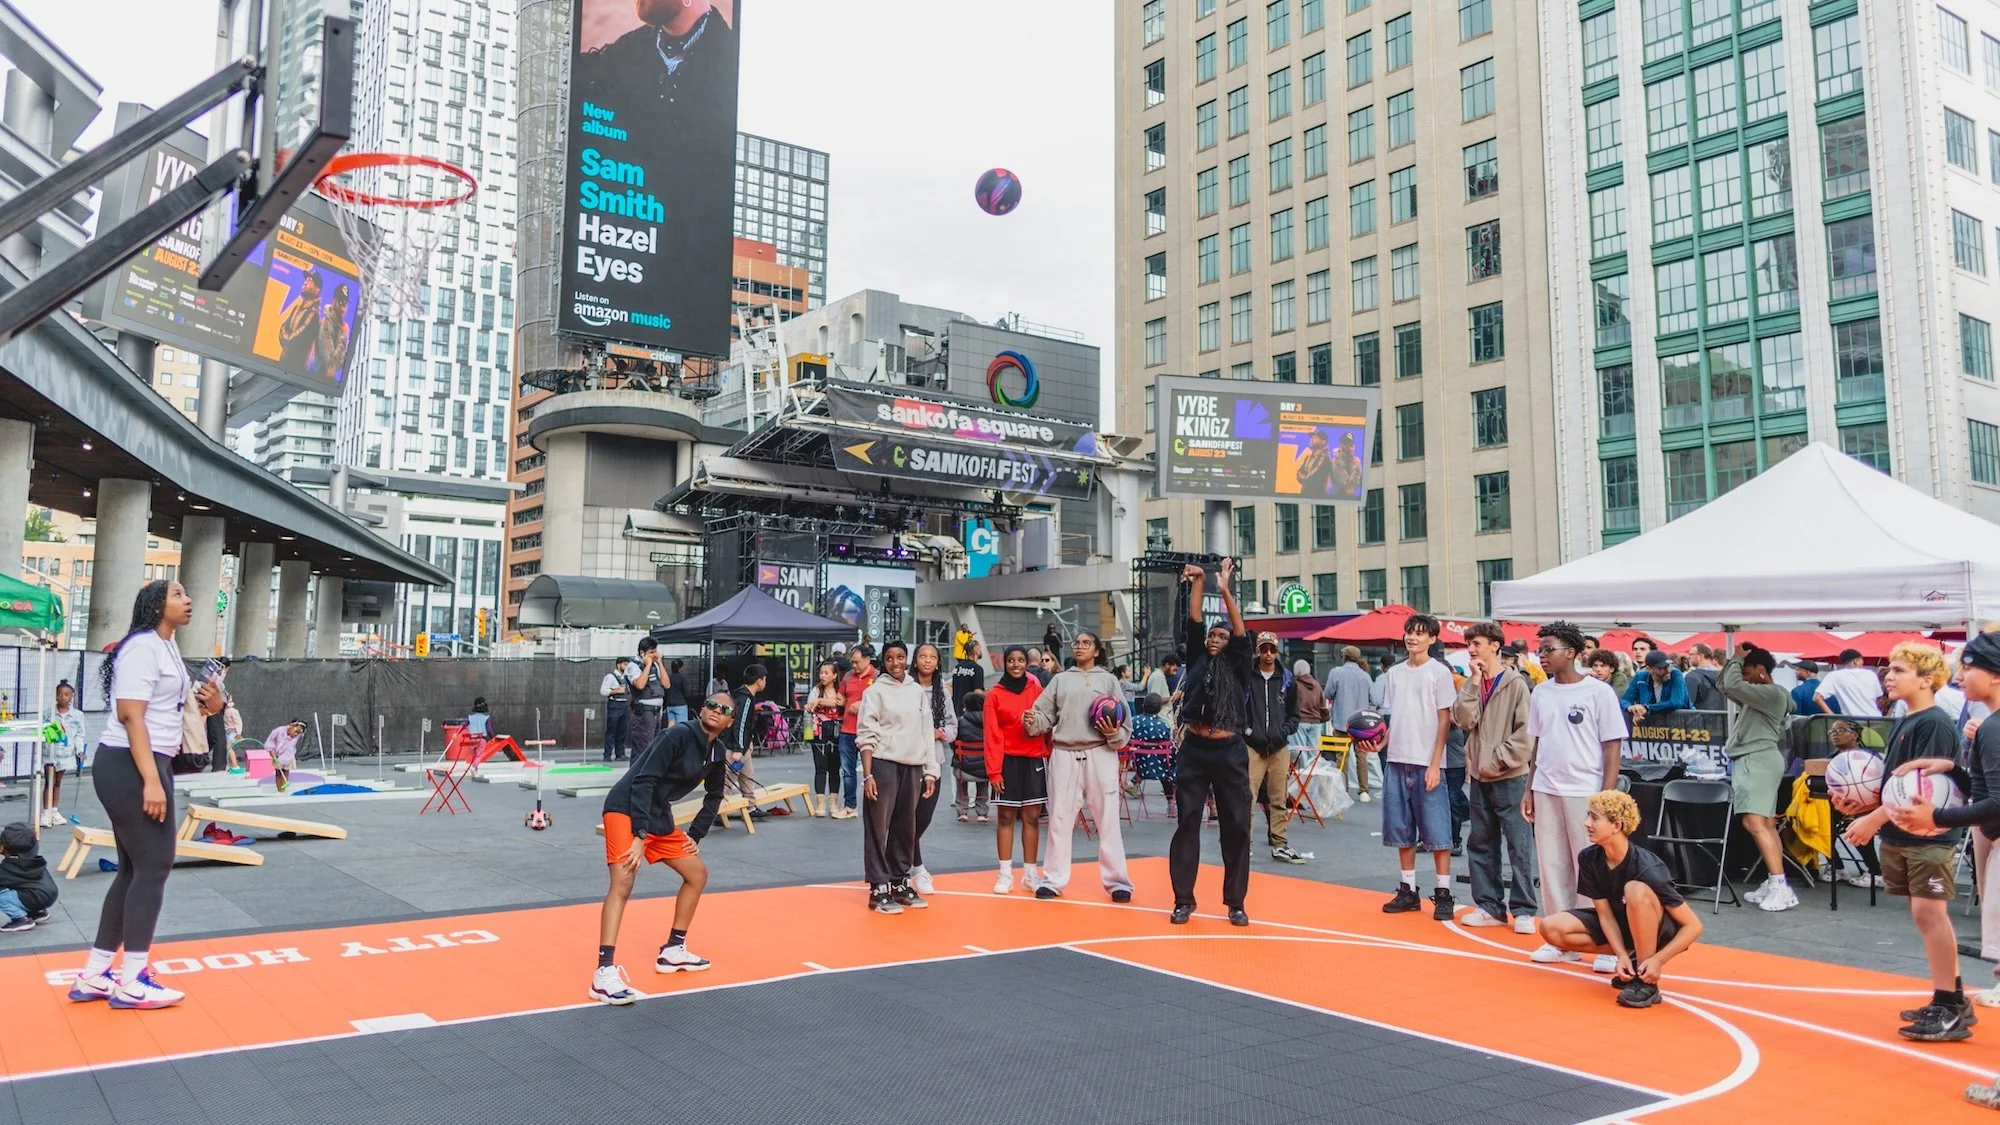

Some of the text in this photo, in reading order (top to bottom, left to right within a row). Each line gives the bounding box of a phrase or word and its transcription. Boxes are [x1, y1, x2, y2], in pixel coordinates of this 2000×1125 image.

[583, 101, 615, 122] New
[582, 120, 627, 141] album
[580, 148, 644, 187] Sam
[579, 181, 665, 223] Smith
[295, 222, 304, 234] 3
[578, 213, 658, 254] Hazel
[154, 247, 188, 272] AUGUST
[577, 245, 644, 284] Eyes
[574, 291, 610, 305] Listen on
[573, 303, 672, 329] amazon music
[1177, 395, 1218, 417] VYBE
[1280, 402, 1302, 412] DAY 3
[877, 402, 1054, 442] sankofa square
[1176, 416, 1231, 439] KINGZ
[1187, 449, 1213, 458] AUGUST
[1214, 450, 1226, 458] 23
[1188, 438, 1244, 450] SANKOFAFEST
[909, 448, 1039, 484] SANKOFAFEST
[971, 528, 999, 555] Ci
[779, 566, 814, 588] SAN
[1202, 595, 1220, 613] AN
[1292, 594, 1305, 612] P
[1632, 726, 1711, 742] AUGUST 21-23
[45, 928, 501, 987] CITY HOOS
